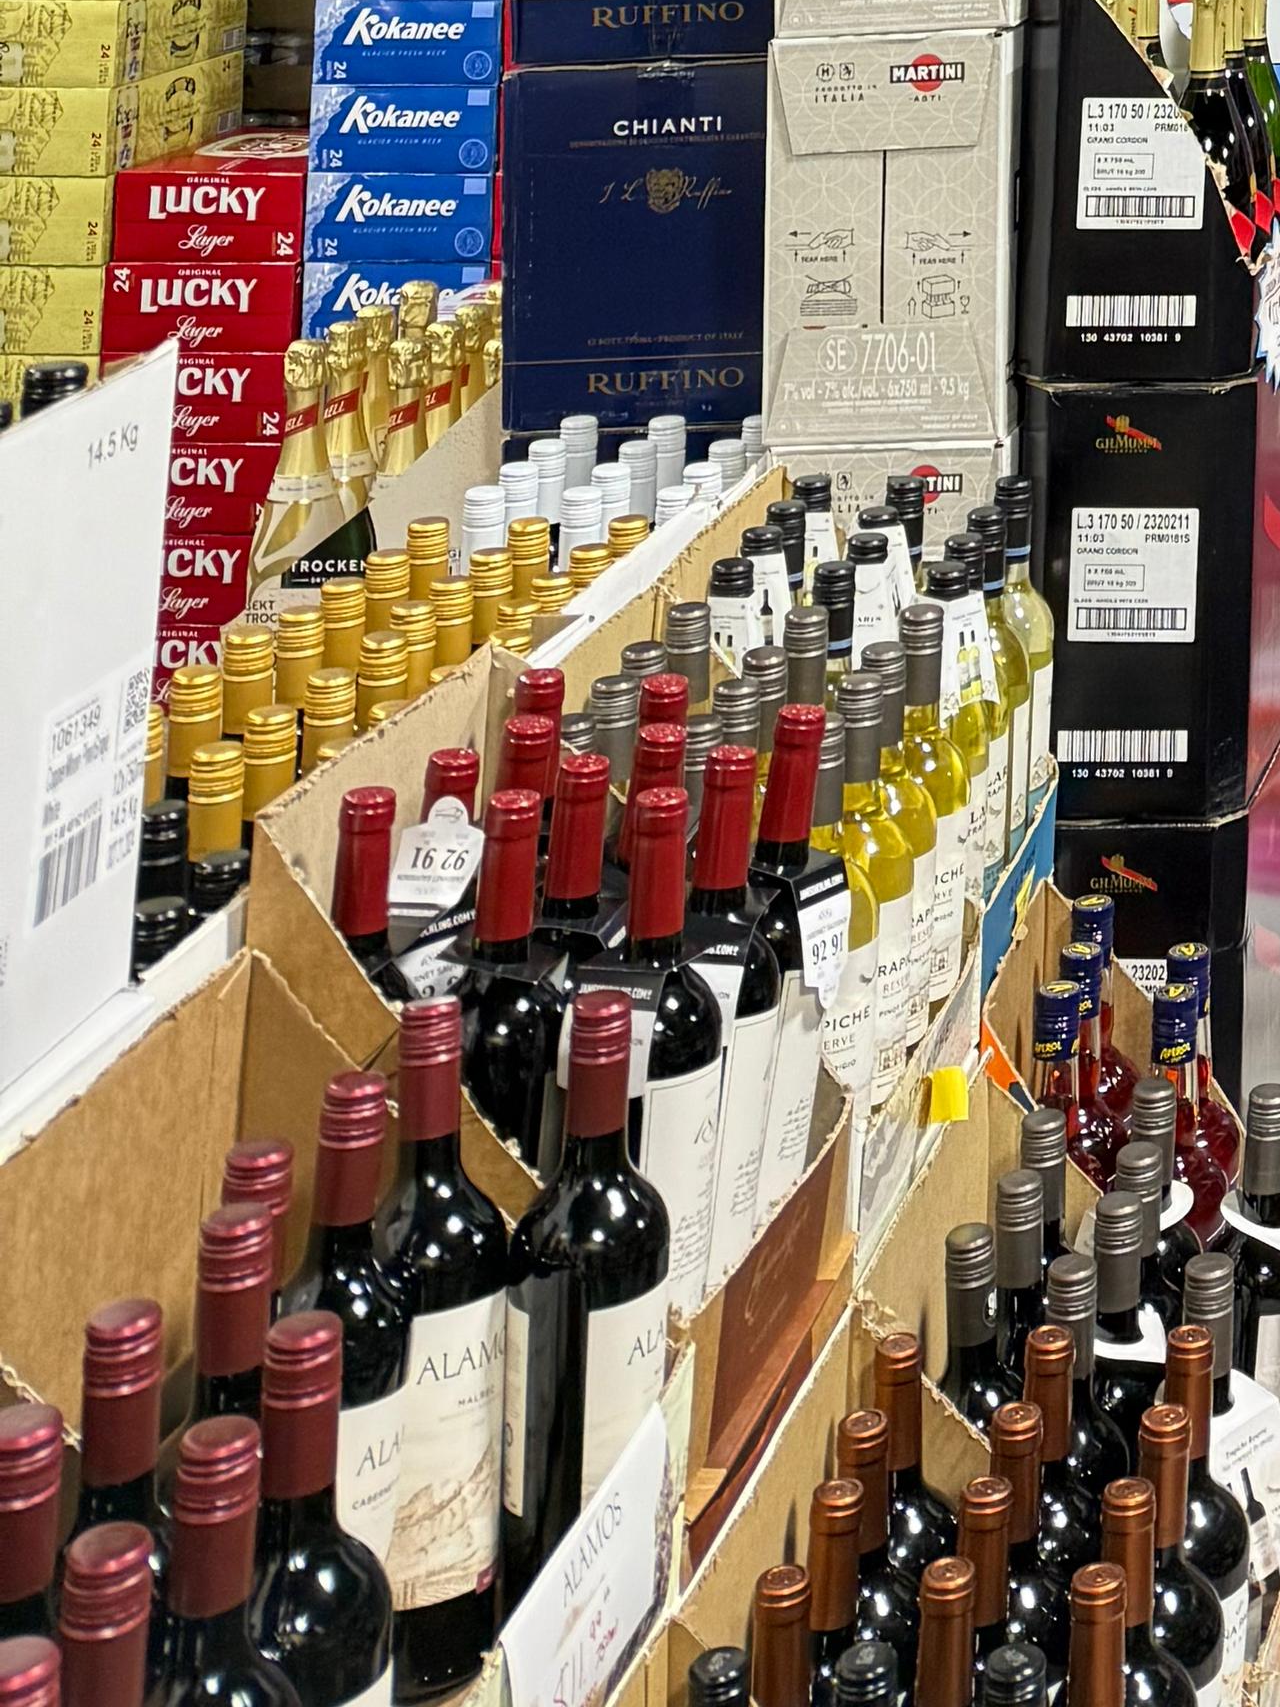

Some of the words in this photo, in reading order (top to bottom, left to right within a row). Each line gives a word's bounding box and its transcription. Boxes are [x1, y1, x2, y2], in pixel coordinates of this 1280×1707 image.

[592, 1, 744, 28] RUFFINO
[892, 63, 962, 82] MARTINI
[339, 96, 460, 133] Kokanee
[613, 116, 723, 137] CHIANTI
[140, 278, 257, 312] LUCKY
[587, 366, 745, 395] RUFFINO
[87, 430, 118, 467] 14.5
[120, 423, 139, 452] Kg
[1098, 514, 1117, 530] 170
[1121, 514, 1134, 530] 50
[1144, 514, 1190, 530] 2320211
[1072, 768, 1089, 778] 130
[562, 1491, 624, 1608] ALAMOS
